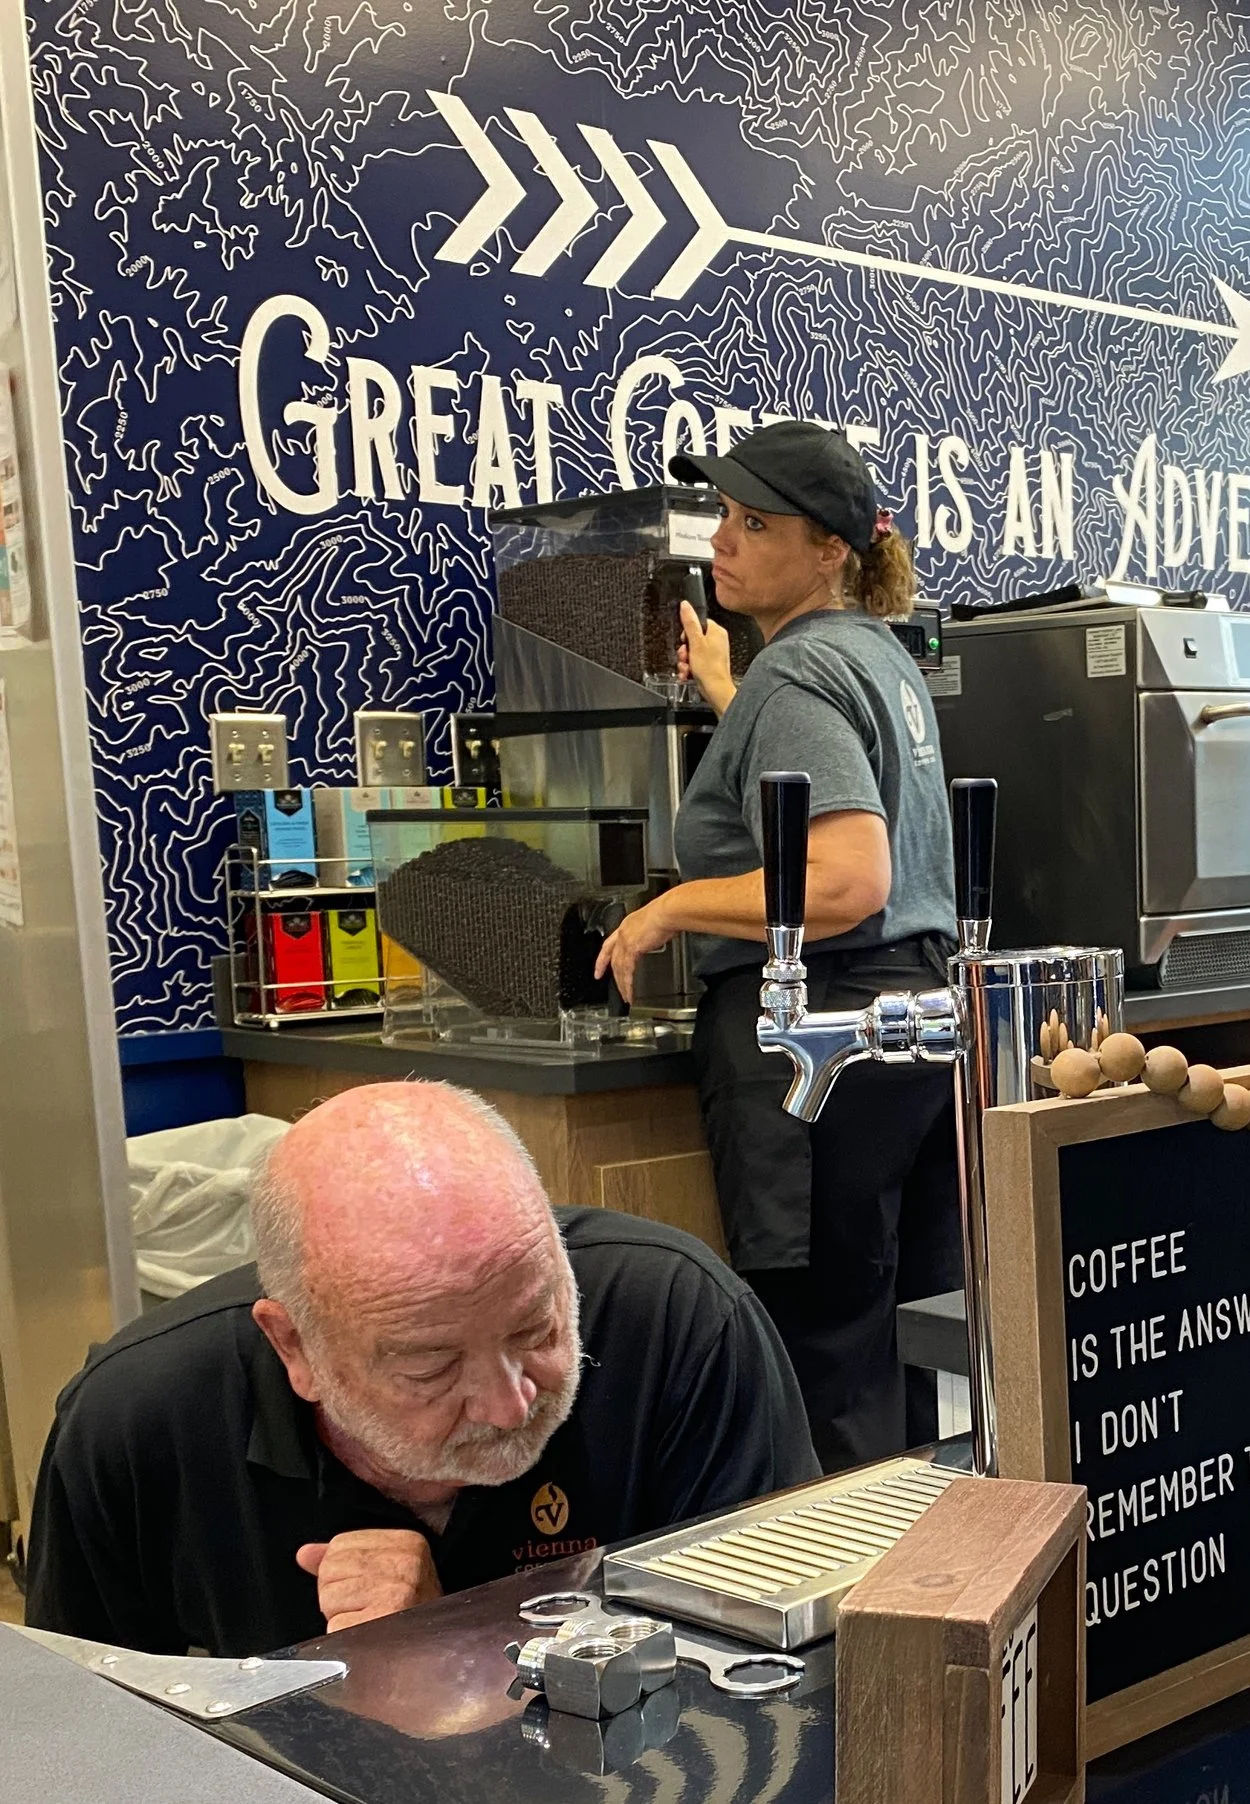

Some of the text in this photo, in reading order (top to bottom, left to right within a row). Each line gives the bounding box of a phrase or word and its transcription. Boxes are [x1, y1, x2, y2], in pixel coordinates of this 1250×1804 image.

[322, 18, 332, 48] 2000
[605, 22, 625, 44] 2750
[743, 33, 760, 53] 3000
[572, 49, 591, 63] 2250
[240, 89, 262, 113] 1750
[142, 141, 164, 170] 2000
[125, 256, 148, 277] 2000
[797, 285, 815, 296] 2750
[904, 294, 921, 312] 3000
[810, 331, 828, 342] 3250
[318, 393, 332, 408] 000
[115, 411, 128, 440] 2250
[239, 295, 563, 514] GREAT
[915, 434, 973, 553] IS
[1000, 447, 1074, 560] AN
[207, 467, 230, 485] 2500
[319, 535, 343, 549] 3000
[142, 587, 168, 600] 2750
[341, 595, 365, 604] 3000
[380, 628, 401, 652] 3250
[124, 678, 150, 695] 3000
[465, 697, 477, 714] 500
[126, 743, 151, 759] 3250
[1069, 1230, 1186, 1298] COFFEE
[1072, 1334, 1098, 1381] IS
[1110, 1315, 1166, 1369] THE
[1075, 1389, 1183, 1464] I DON'T
[1086, 1453, 1234, 1541] REMEMBER
[512, 1537, 598, 1560] vienna
[1086, 1533, 1226, 1627] QUESTION
